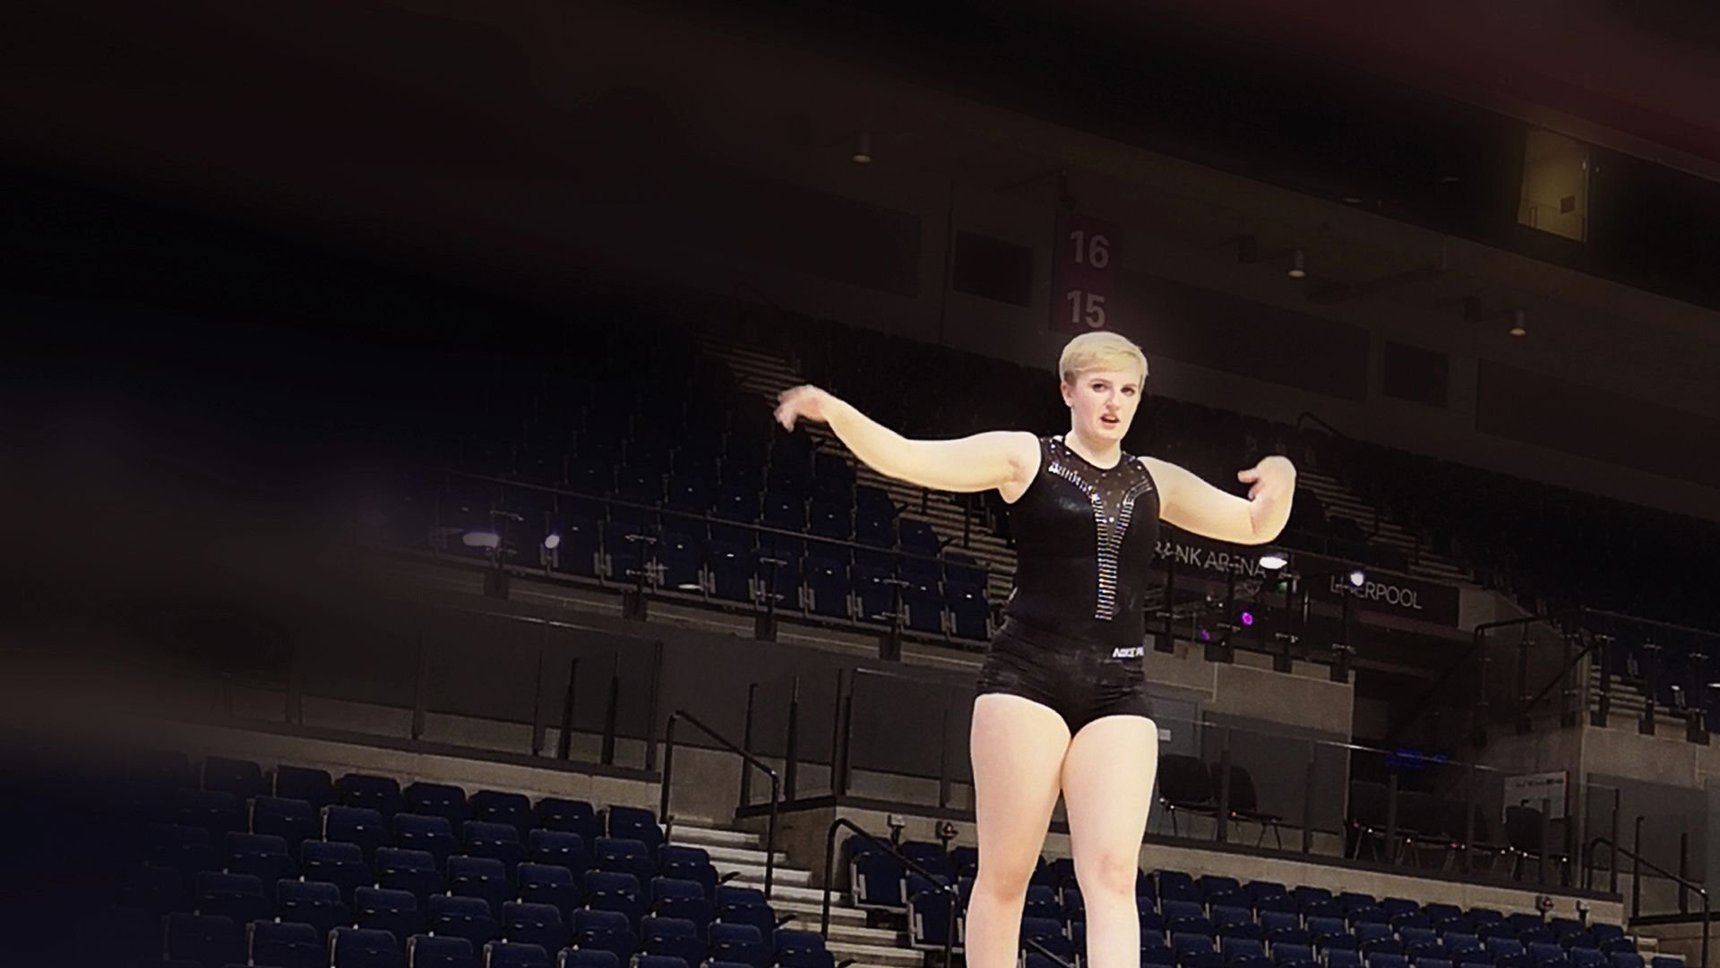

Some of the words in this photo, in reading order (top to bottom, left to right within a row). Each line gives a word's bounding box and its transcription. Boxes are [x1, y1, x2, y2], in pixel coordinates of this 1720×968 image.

[1070, 230, 1109, 269] 16
[1067, 290, 1105, 328] 15
[1330, 575, 1422, 609] LIERPOOL
